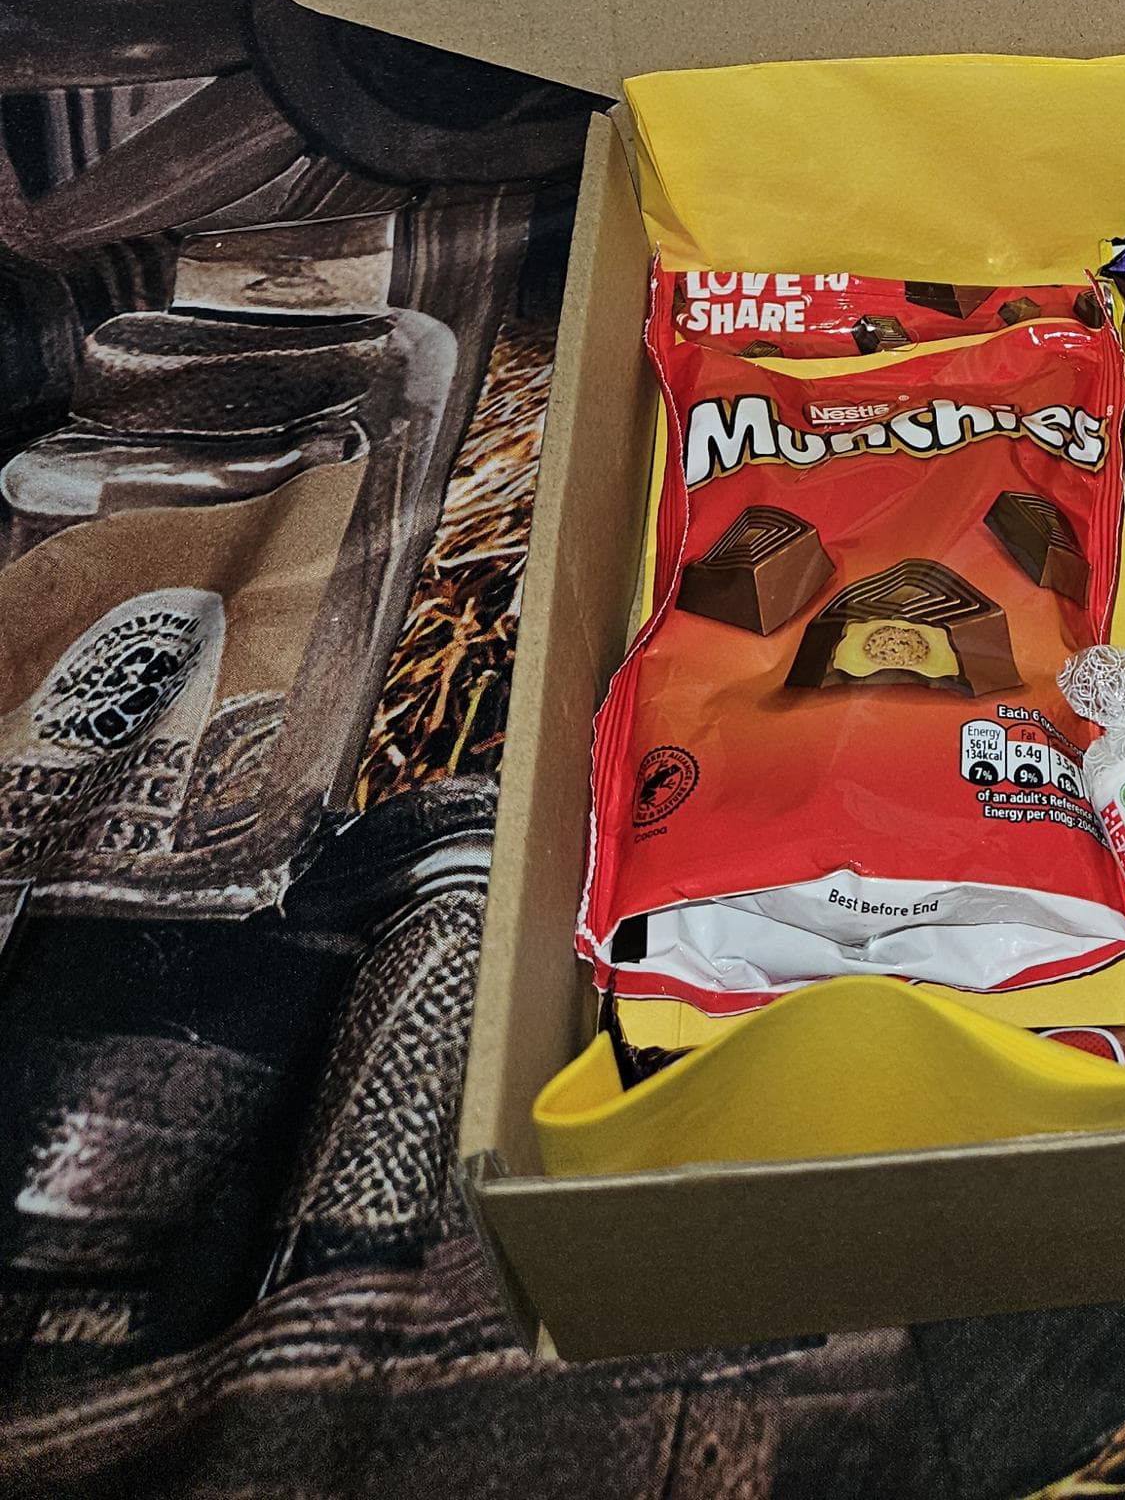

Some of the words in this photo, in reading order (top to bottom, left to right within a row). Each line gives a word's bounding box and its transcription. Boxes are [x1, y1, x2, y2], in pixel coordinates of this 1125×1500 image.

[686, 299, 805, 335] SHARE
[685, 396, 1107, 486] Munchies
[998, 706, 1029, 719] Each
[968, 726, 1001, 740] Energy
[1021, 729, 1036, 740] Fat
[970, 739, 998, 750] 561kJ
[966, 749, 1003, 760] 134kcal
[1015, 745, 1042, 762] 6.4g
[974, 767, 993, 781] 7%
[1020, 770, 1038, 783] 9%
[978, 790, 991, 801] of
[993, 793, 1006, 802] an
[1010, 792, 1047, 805] adult's
[985, 806, 1024, 821] Energy
[1027, 809, 1045, 821] per
[1049, 810, 1076, 827] 100g:
[828, 889, 859, 912] Best
[860, 901, 909, 917] Before
[912, 899, 938, 916] End
